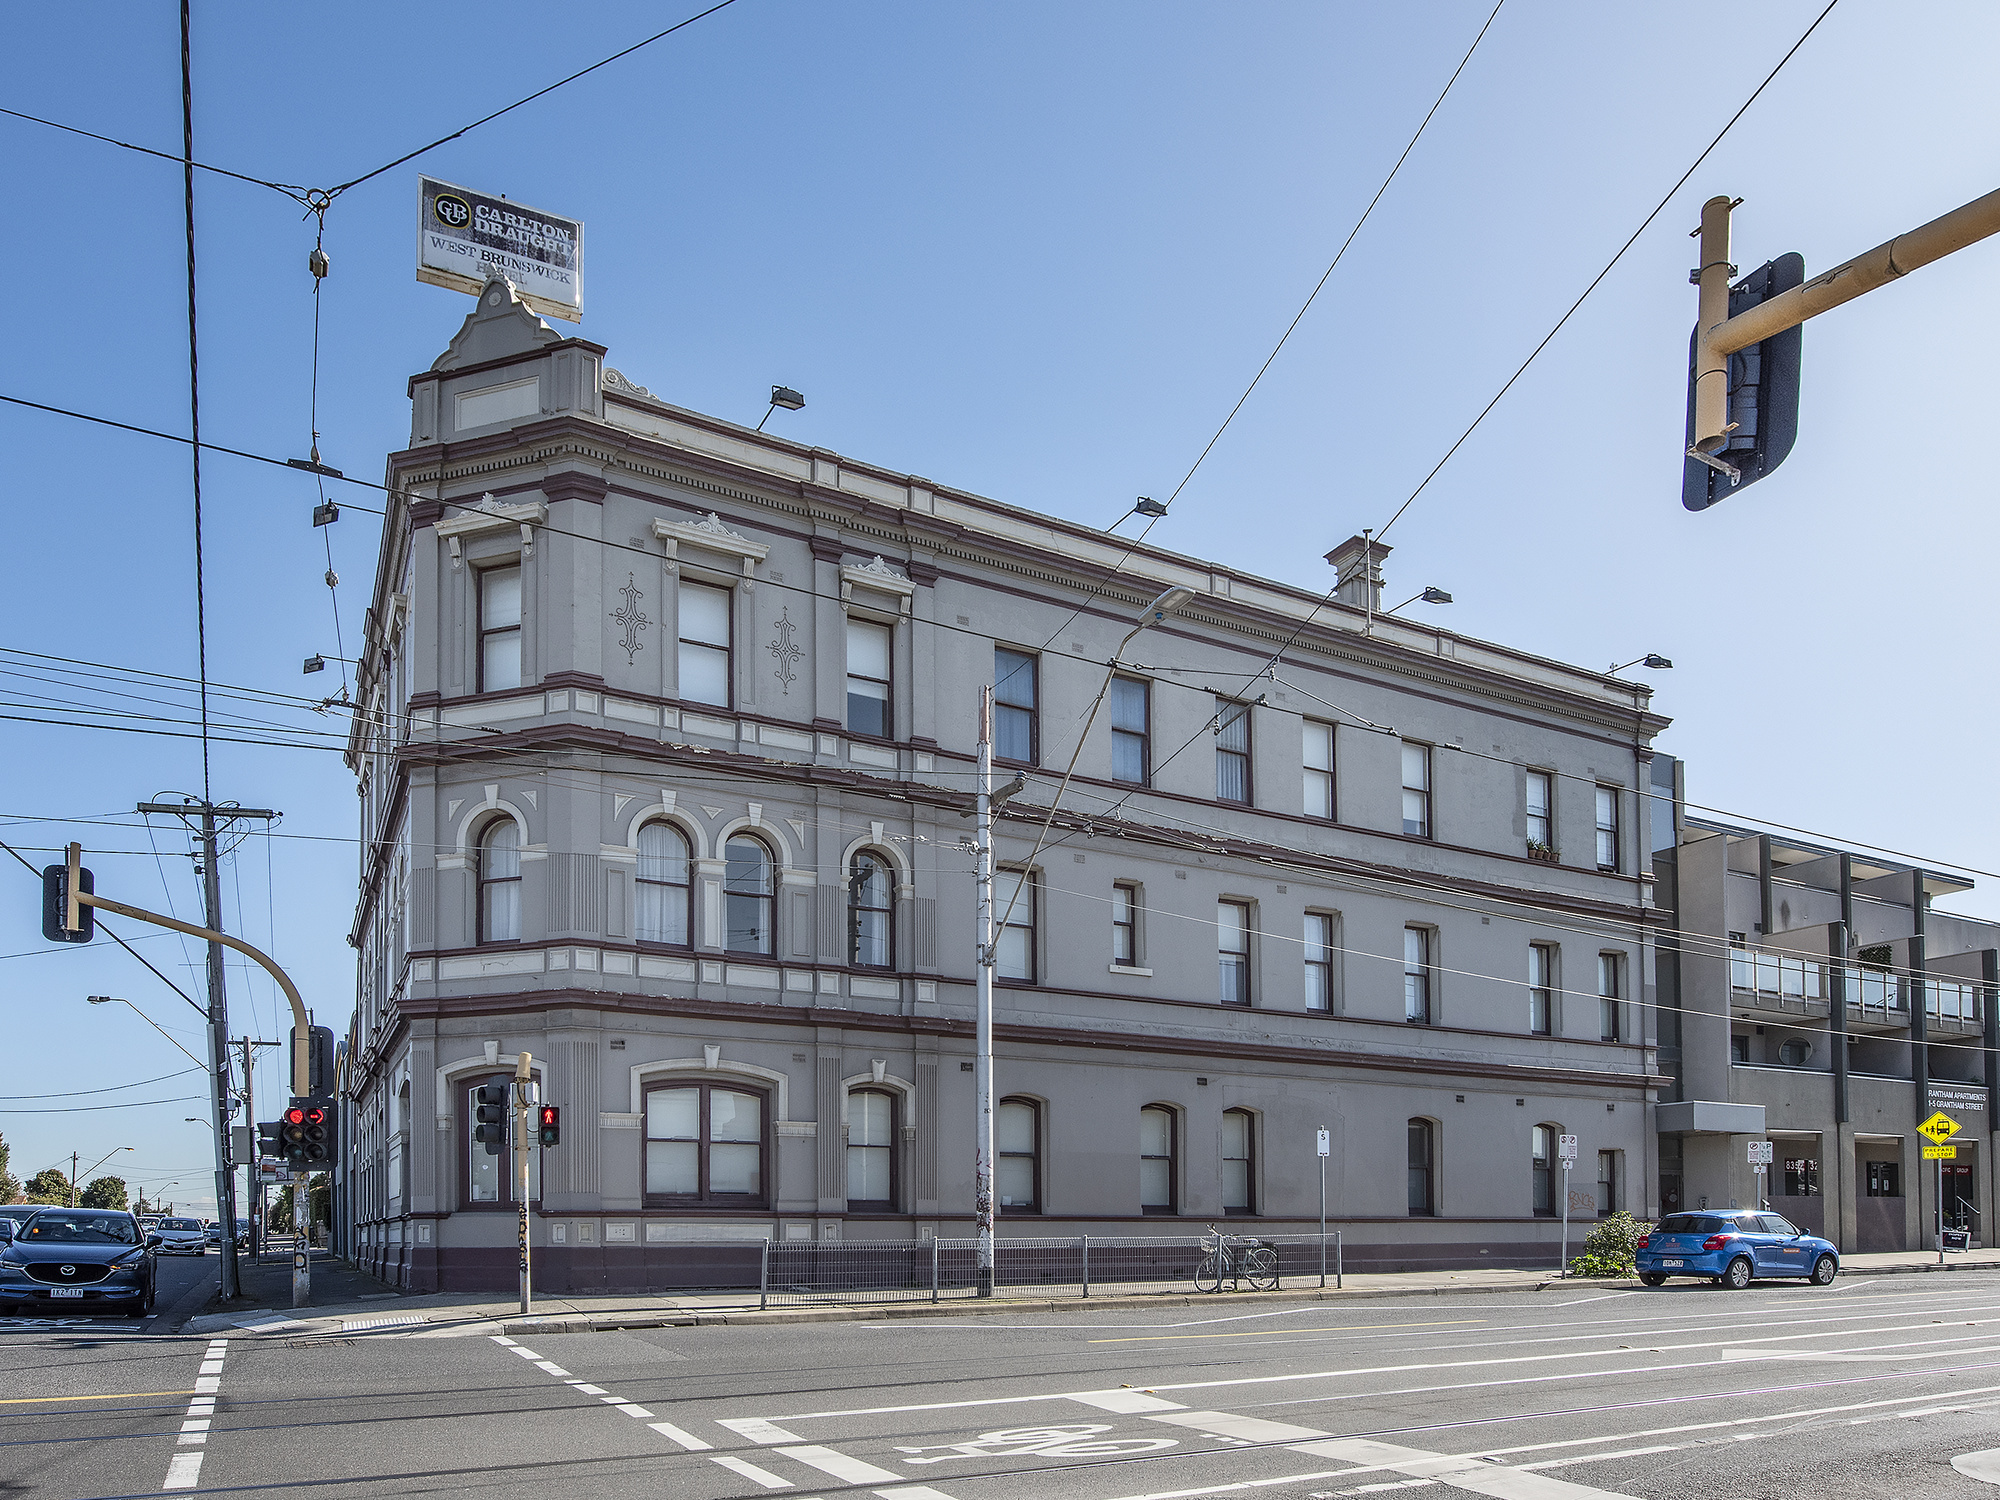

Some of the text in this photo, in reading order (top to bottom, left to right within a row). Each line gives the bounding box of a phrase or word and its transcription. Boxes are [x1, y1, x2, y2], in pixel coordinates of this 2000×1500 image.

[474, 217, 572, 256] DRAUGHT
[475, 204, 571, 241] CARLTON
[430, 235, 571, 285] WEST BRUNSWICK
[1936, 1100, 1965, 1109] GRANTHAM
[1964, 1102, 1984, 1110] STREET
[1954, 1091, 1987, 1102] APARTMENTS
